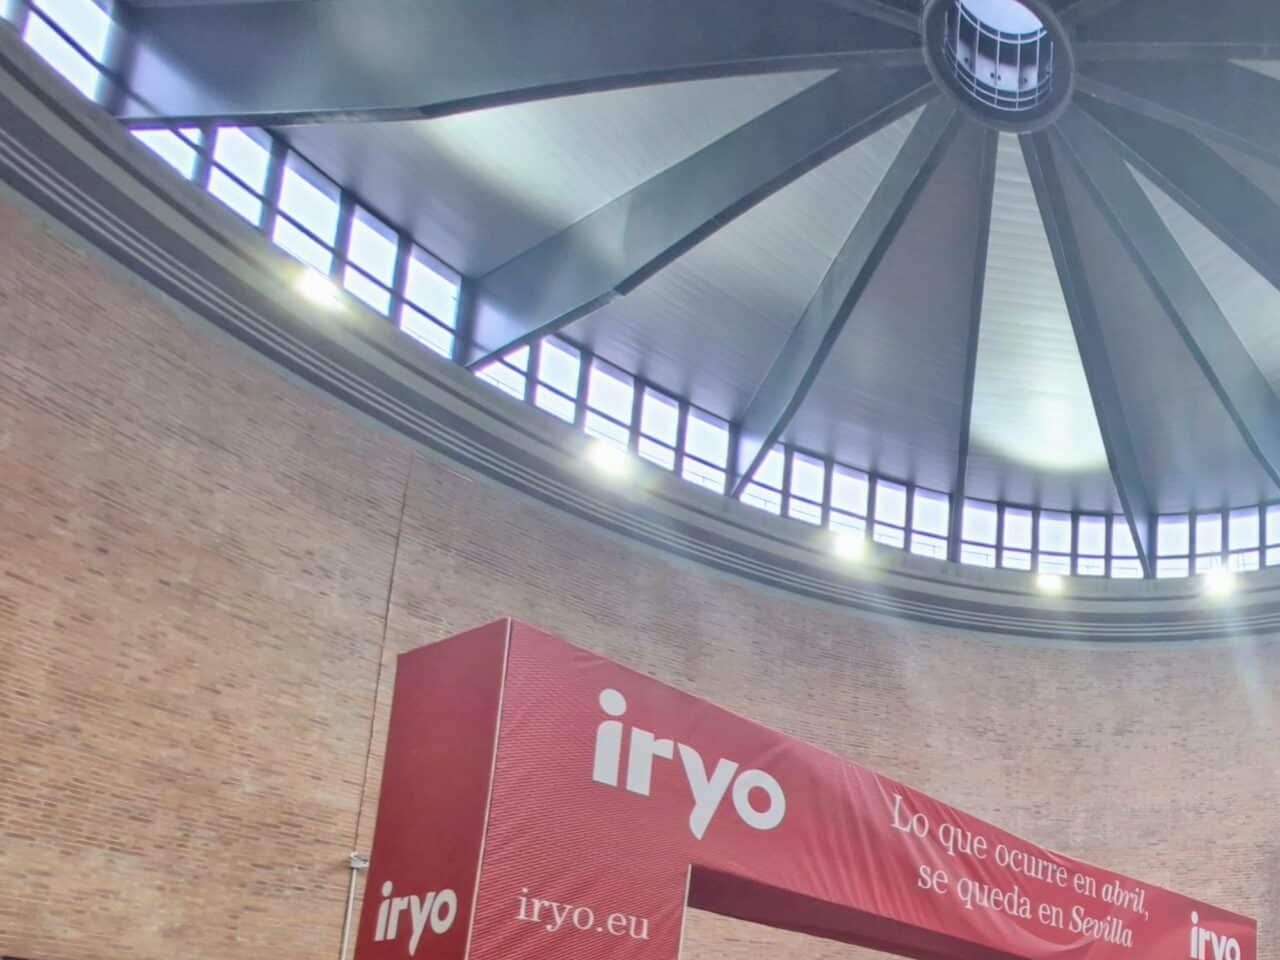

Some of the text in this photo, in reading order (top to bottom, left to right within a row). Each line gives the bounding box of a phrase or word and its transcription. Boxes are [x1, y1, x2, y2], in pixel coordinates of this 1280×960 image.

[592, 688, 787, 841] iryo
[890, 793, 1149, 922] Lo que ocurre en abril,
[374, 880, 457, 956] iryo
[516, 888, 650, 940] iryo.eu
[917, 863, 1134, 949] se queda en Sevilla
